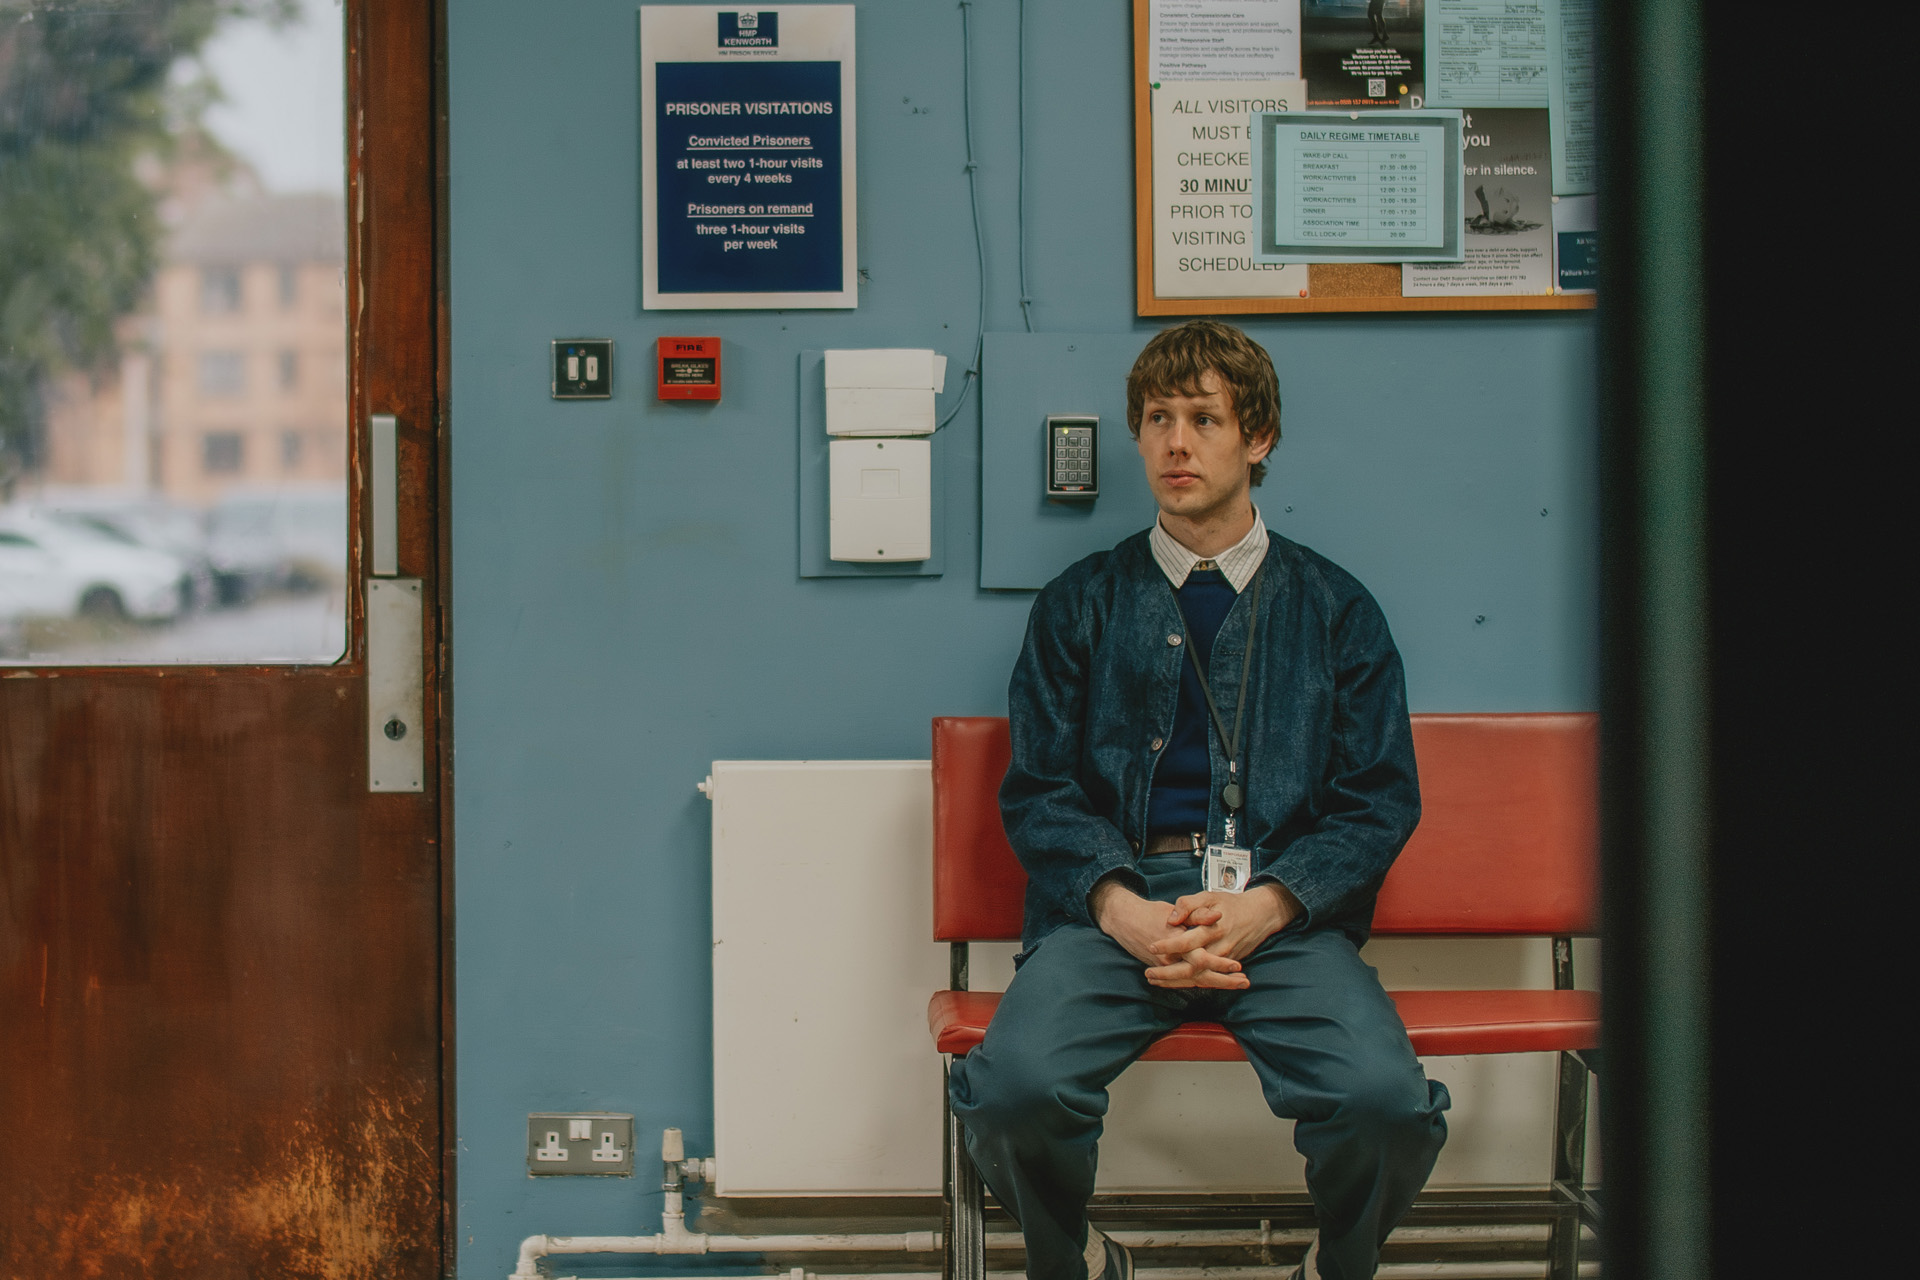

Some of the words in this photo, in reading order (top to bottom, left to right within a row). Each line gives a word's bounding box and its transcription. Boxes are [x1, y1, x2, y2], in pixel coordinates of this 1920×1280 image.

[738, 30, 758, 38] HMP
[724, 38, 772, 46] KENWORTH
[666, 103, 741, 116] PRISONER
[745, 102, 833, 115] VISITATIONS
[1172, 100, 1203, 114] ALL
[1208, 99, 1288, 114] VISITORS
[1411, 96, 1424, 110] D
[1193, 126, 1241, 140] MUST
[688, 135, 750, 147] Convicted
[752, 135, 811, 146] Prisoners
[1463, 135, 1490, 149] you
[677, 160, 688, 169] at
[691, 159, 721, 169] least
[723, 159, 746, 169] two
[749, 158, 788, 168] 1-hour
[790, 158, 823, 168] visits
[1178, 152, 1250, 166] CHECKE
[1464, 165, 1477, 175] fer
[1481, 165, 1491, 175] in
[1494, 164, 1537, 175] silence.
[708, 175, 740, 186] every
[744, 174, 752, 183] 4
[754, 173, 792, 183] weeks
[1180, 179, 1199, 193] 30
[1205, 179, 1252, 192] MINU
[688, 204, 746, 214] Prisoners
[749, 206, 764, 214] on
[768, 203, 813, 214] remand
[1171, 205, 1224, 218] PRIOR
[1230, 205, 1253, 218] TO
[696, 224, 728, 234] three
[731, 224, 770, 234] 1-hour
[773, 224, 805, 234] visits
[1172, 231, 1246, 245] VISITING
[724, 241, 744, 252] per
[747, 239, 778, 249] week
